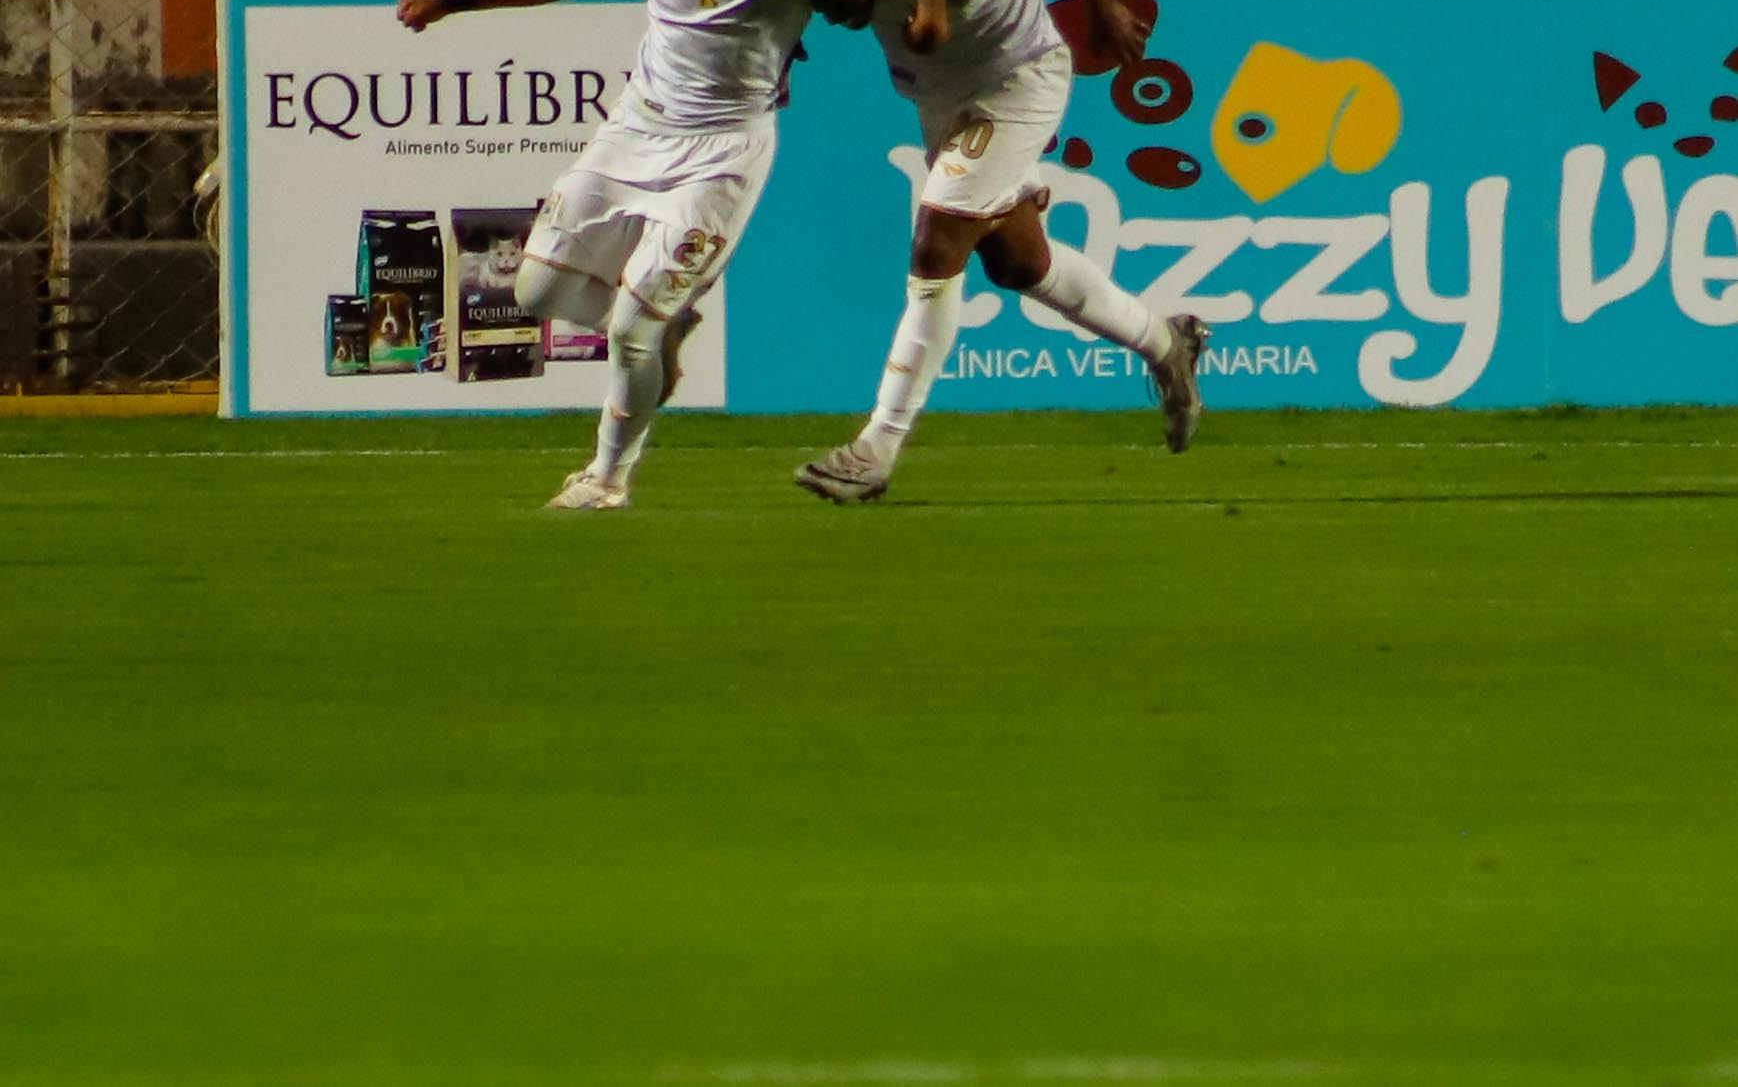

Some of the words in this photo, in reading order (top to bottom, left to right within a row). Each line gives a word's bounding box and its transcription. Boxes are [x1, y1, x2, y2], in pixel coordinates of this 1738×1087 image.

[264, 58, 632, 140] EQUILÍBR
[385, 139, 460, 155] Alimento
[465, 139, 514, 157] Super
[936, 343, 1058, 379] LÍNICA
